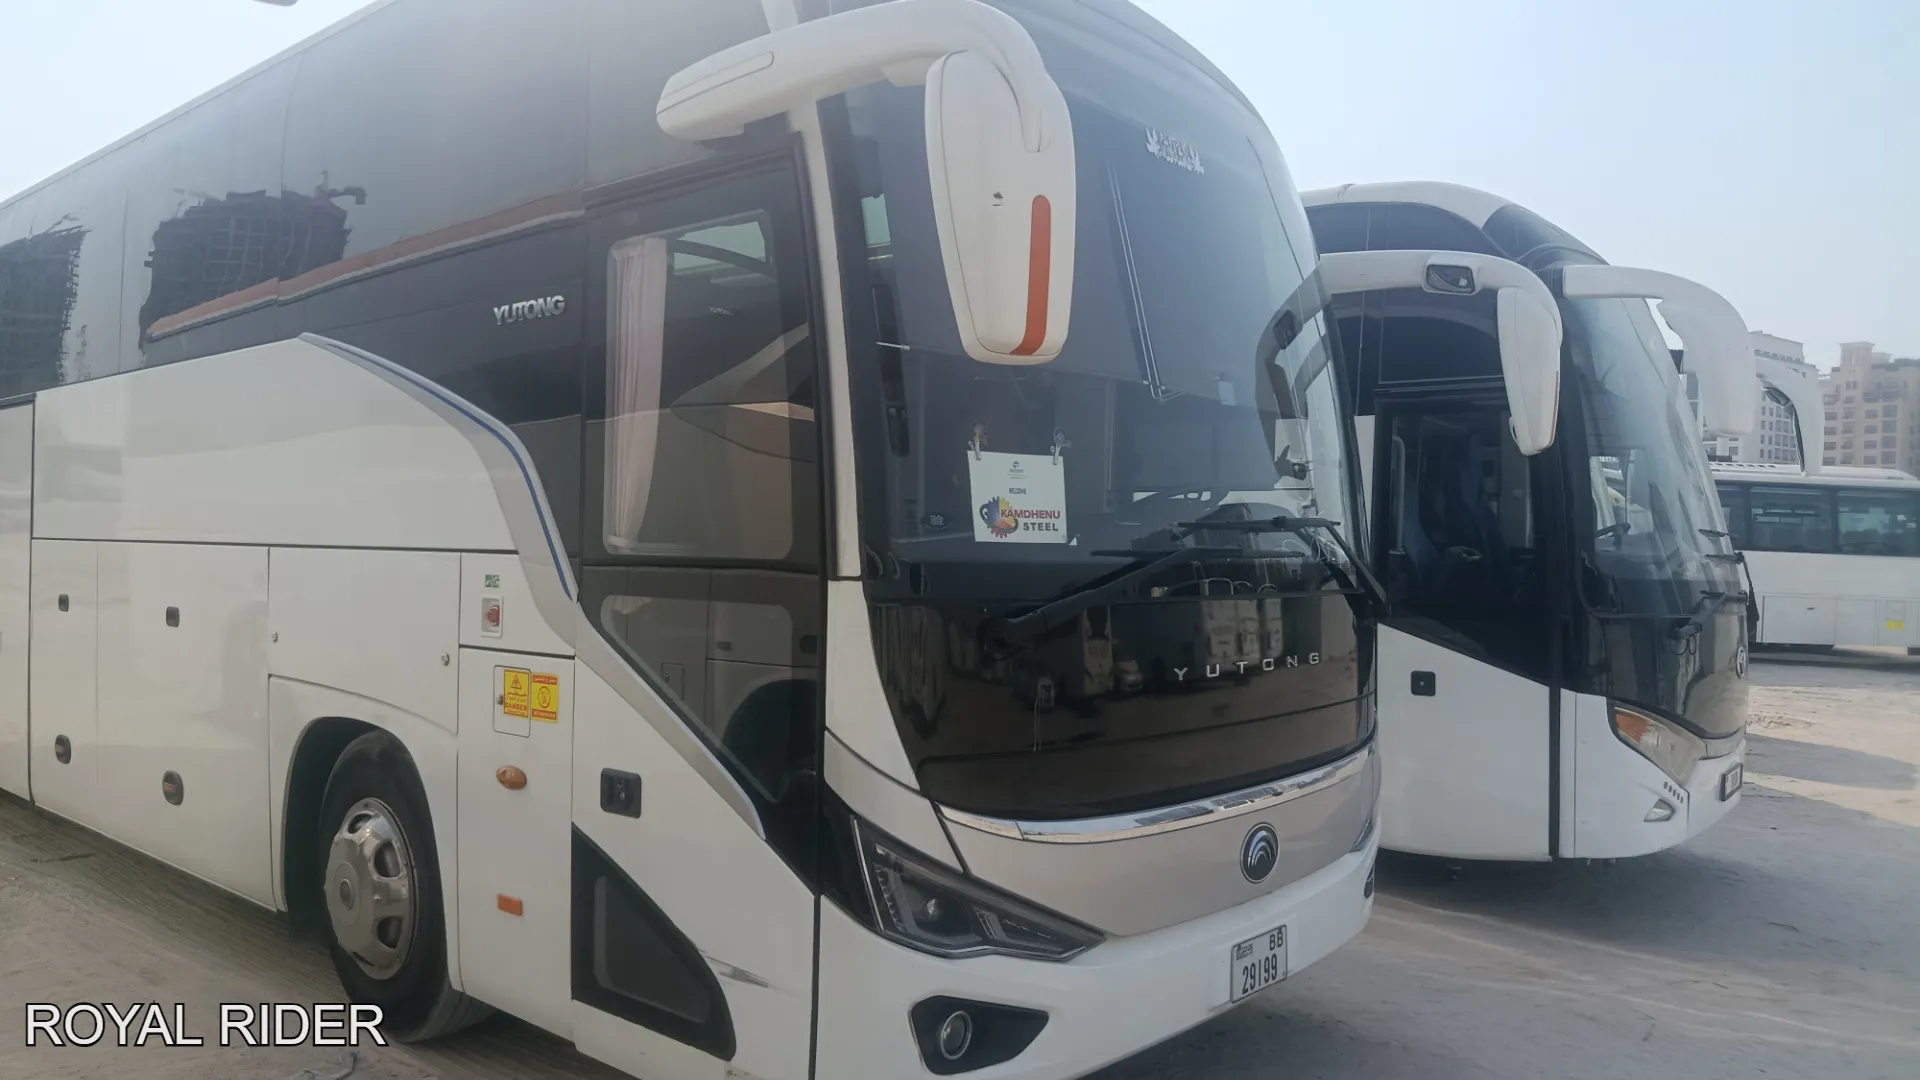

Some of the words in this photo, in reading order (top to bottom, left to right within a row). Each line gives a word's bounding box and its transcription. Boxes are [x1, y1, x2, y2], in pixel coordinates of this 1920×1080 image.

[493, 294, 565, 326] YUTONG
[1000, 508, 1061, 519] KAMDHENU
[1023, 522, 1059, 531] STEEL
[1173, 652, 1320, 681] YUTONG
[1269, 930, 1284, 951] BB
[1242, 953, 1278, 995] 29199
